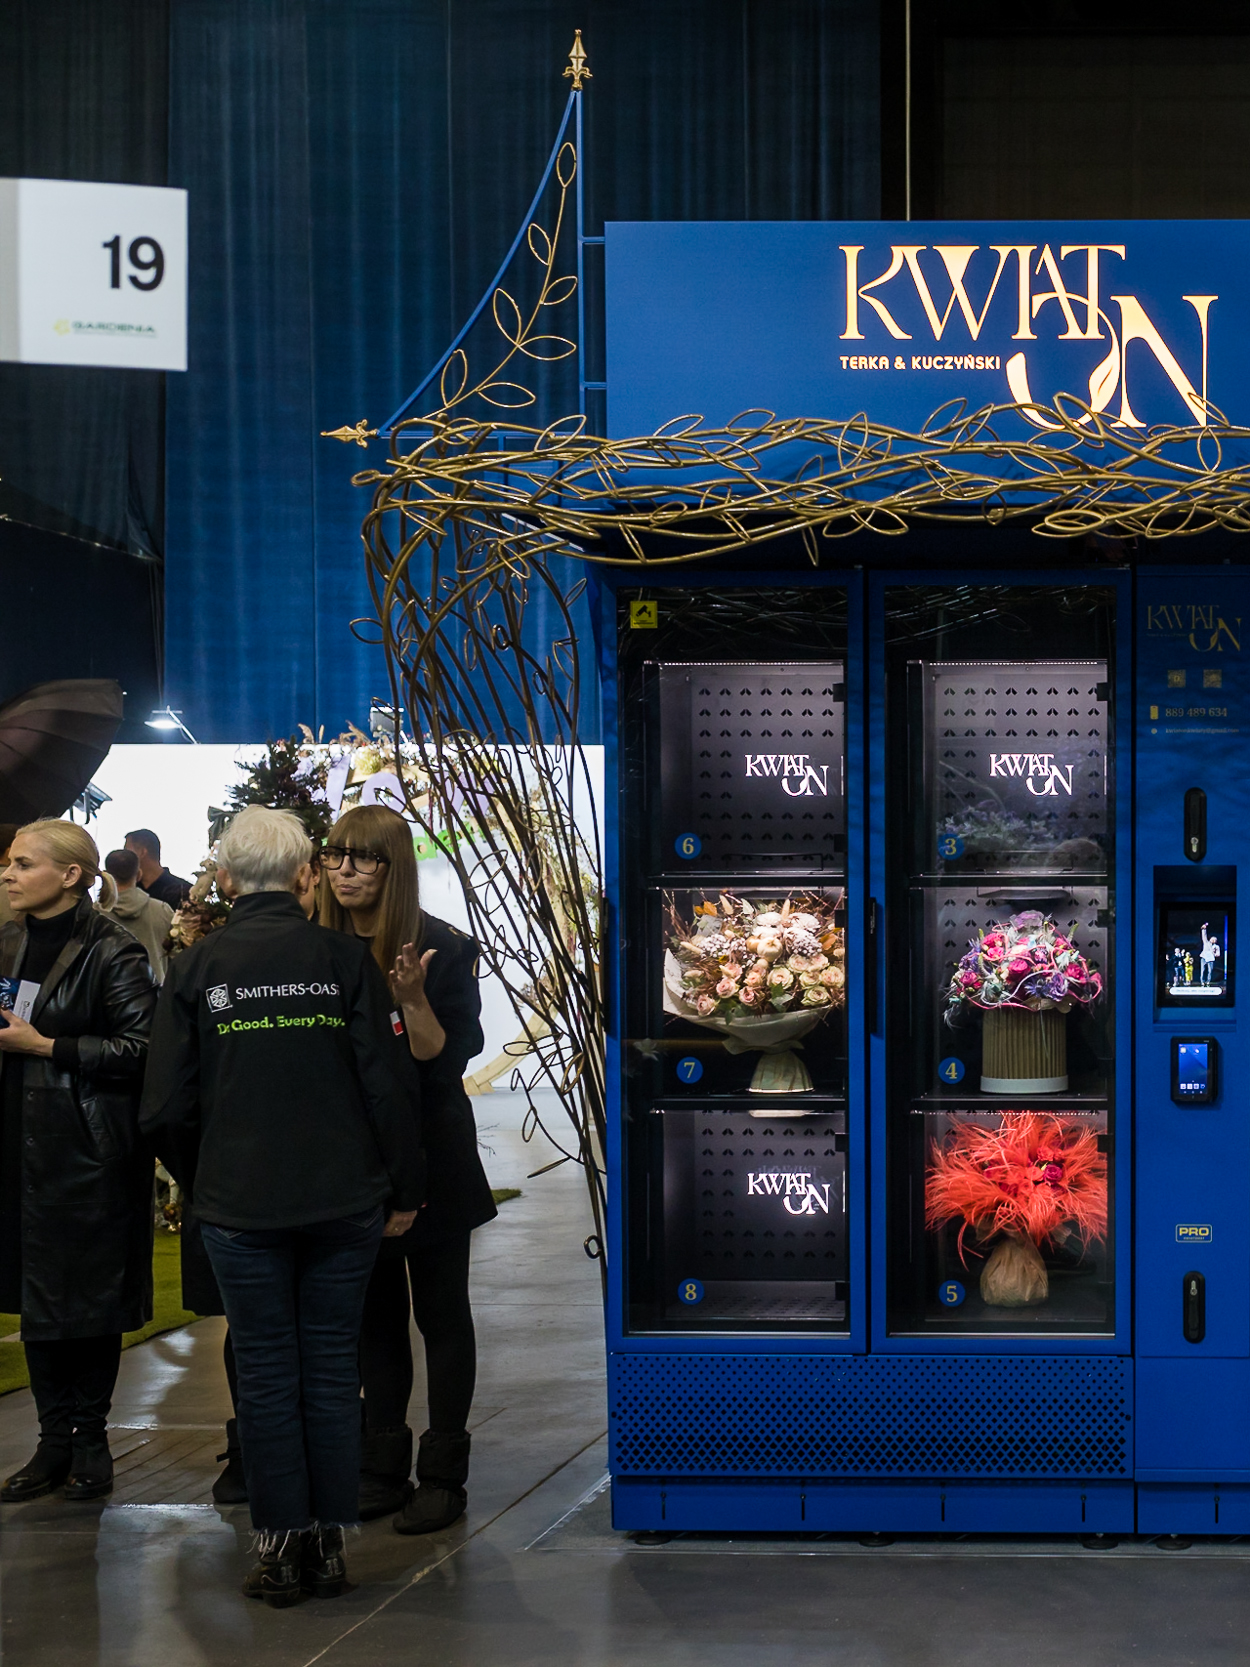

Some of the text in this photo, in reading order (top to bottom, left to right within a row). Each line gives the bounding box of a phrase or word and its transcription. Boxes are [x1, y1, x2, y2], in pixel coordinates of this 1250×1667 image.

[102, 234, 165, 292] 19
[839, 353, 1001, 371] TERKA & KUCZYŃSKI
[682, 838, 694, 855] 6
[945, 838, 957, 855] 3
[231, 1016, 274, 1031] Good.
[276, 1015, 315, 1028] Every
[683, 1063, 695, 1079] 7
[945, 1063, 958, 1079] 4
[1179, 1227, 1209, 1236] PRO
[684, 1283, 697, 1301] 8
[946, 1286, 957, 1303] 5
